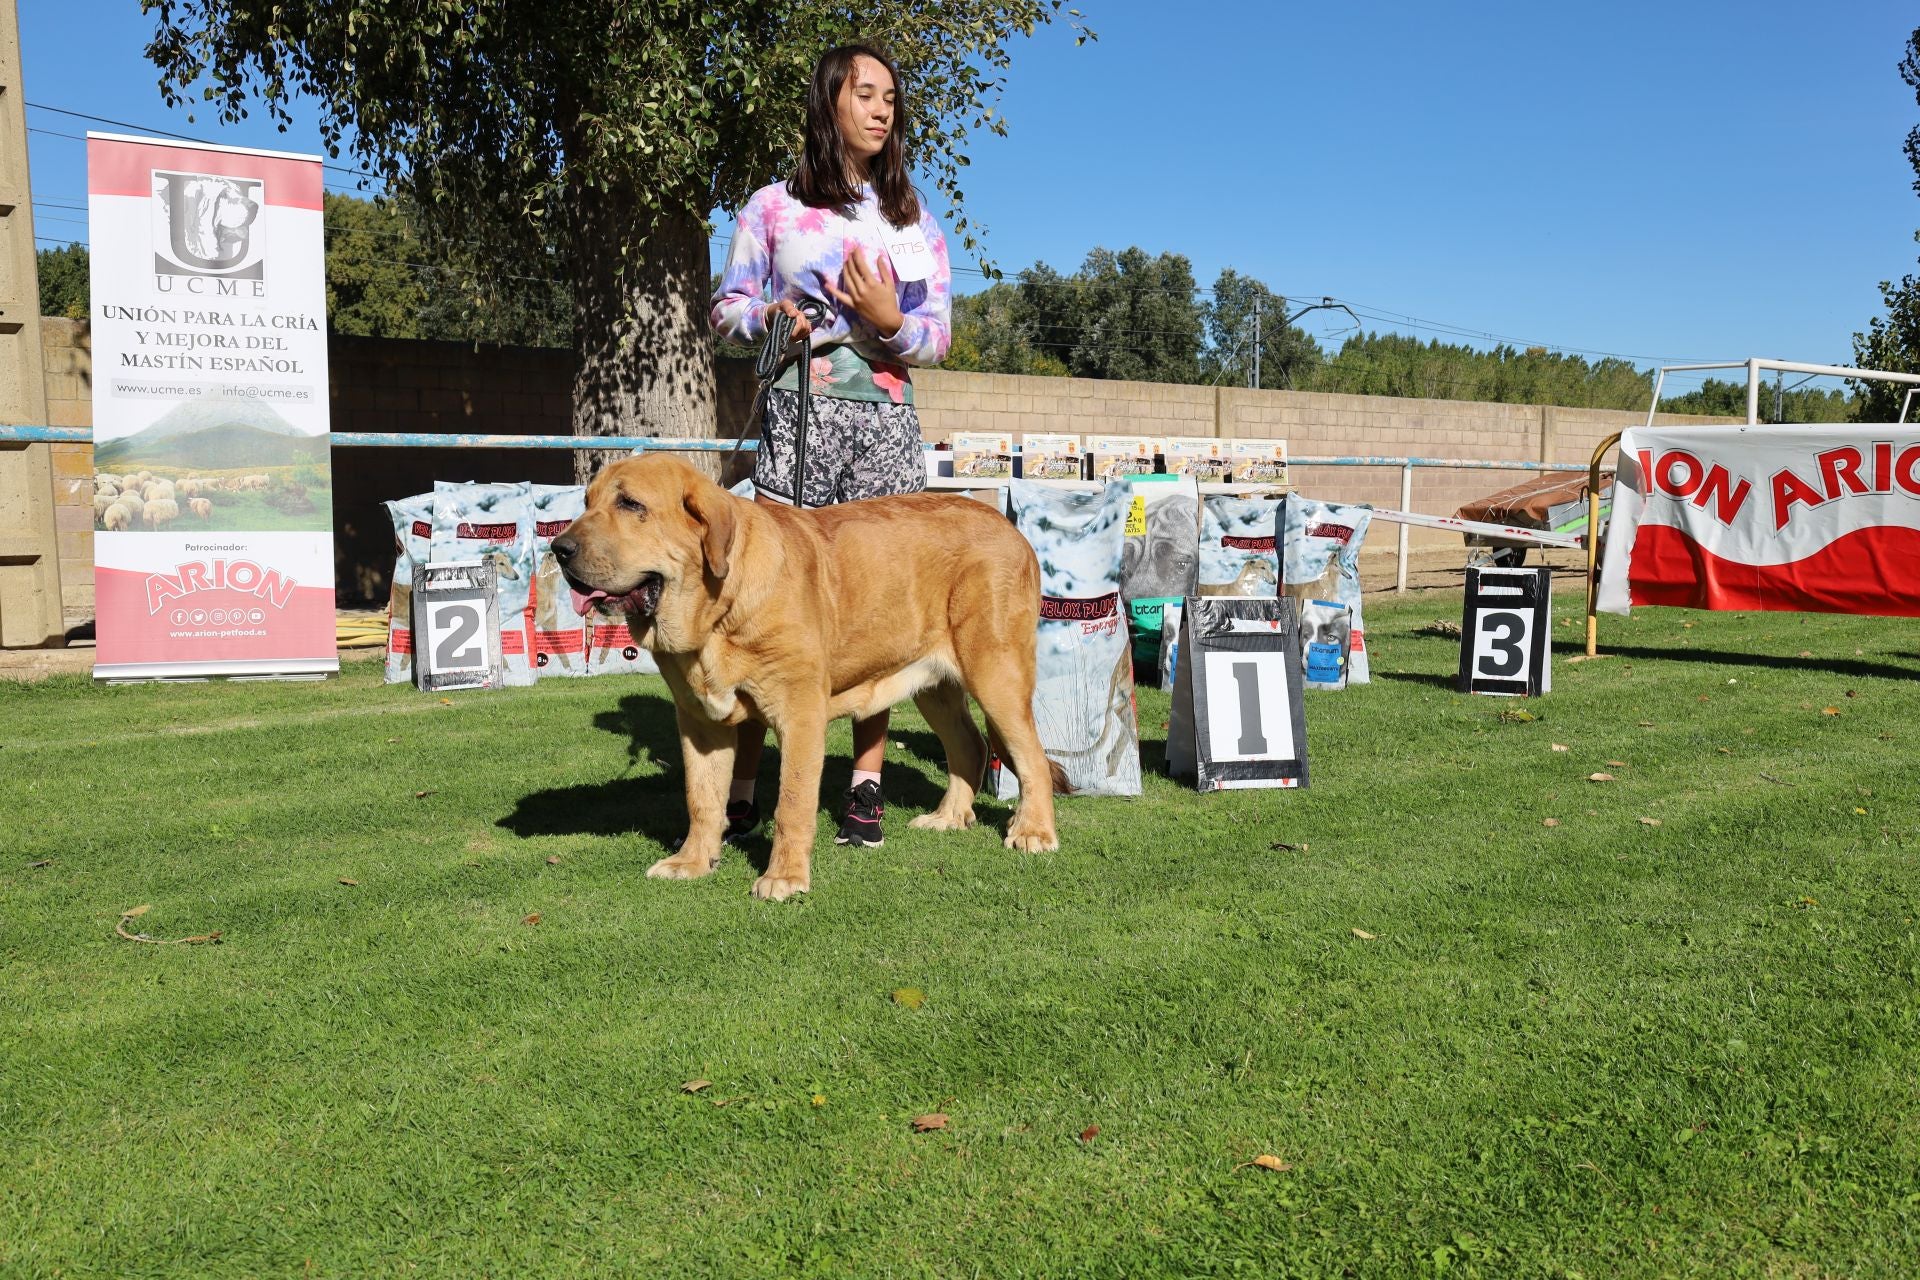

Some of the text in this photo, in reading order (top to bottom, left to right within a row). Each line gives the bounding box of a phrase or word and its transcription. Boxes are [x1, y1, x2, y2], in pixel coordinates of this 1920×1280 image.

[891, 241, 925, 255] OTIS
[156, 275, 265, 298] UCME
[102, 305, 319, 331] UNIÓN PARA LA CRÍA
[136, 331, 288, 351] Y MEJORA DEL
[121, 353, 304, 374] MASTÍN ESPAÑOL
[117, 384, 309, 399] www.ucme.es info@ucme.es
[184, 543, 248, 552] Patrocinador:
[145, 558, 297, 616] ARION
[1082, 597, 1118, 619] PLUS
[170, 628, 267, 639] www.arion-petfood.es
[435, 604, 483, 669] 2
[1478, 612, 1526, 678] 3
[1232, 661, 1268, 756] 1
